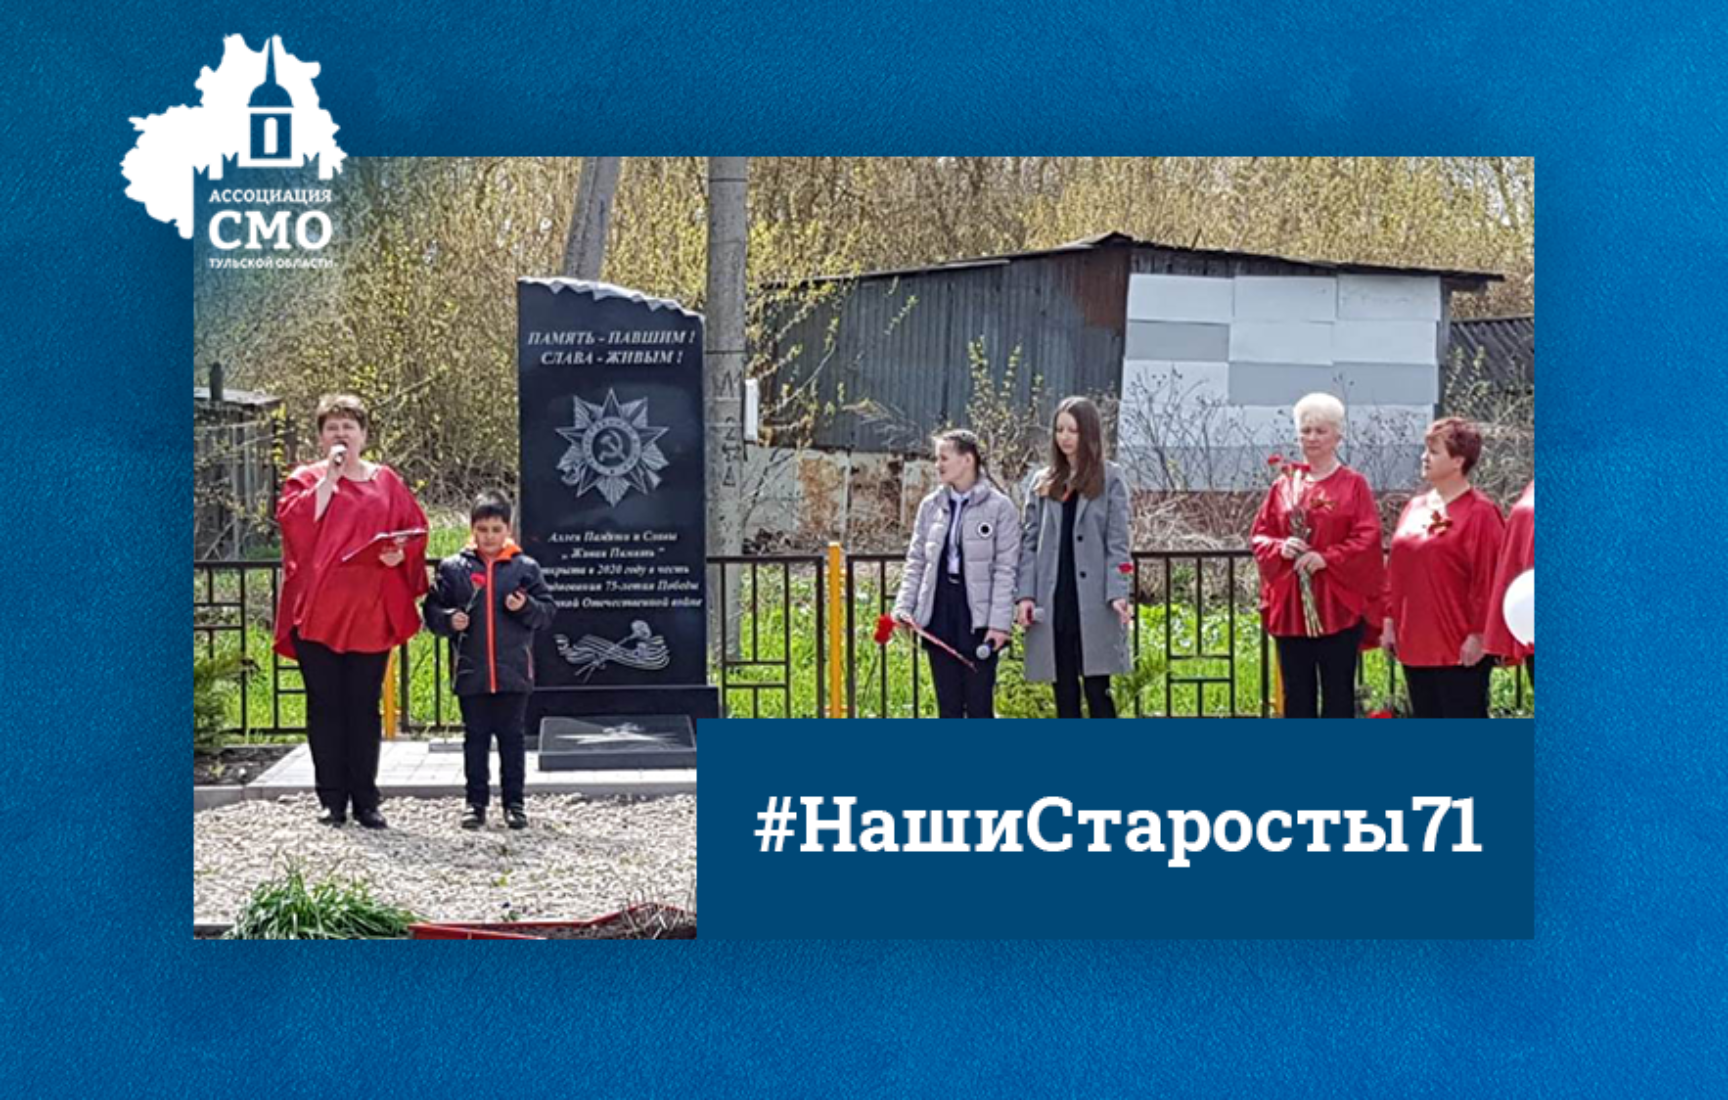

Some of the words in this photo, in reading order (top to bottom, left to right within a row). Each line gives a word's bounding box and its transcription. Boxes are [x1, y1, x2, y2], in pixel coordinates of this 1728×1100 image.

[528, 331, 595, 346] ПАМЯТЬ
[607, 330, 686, 344] ПАВШИМ
[540, 351, 593, 365] СЛАВА
[605, 351, 673, 365] ЖИВЫМ
[597, 564, 622, 575] 2020
